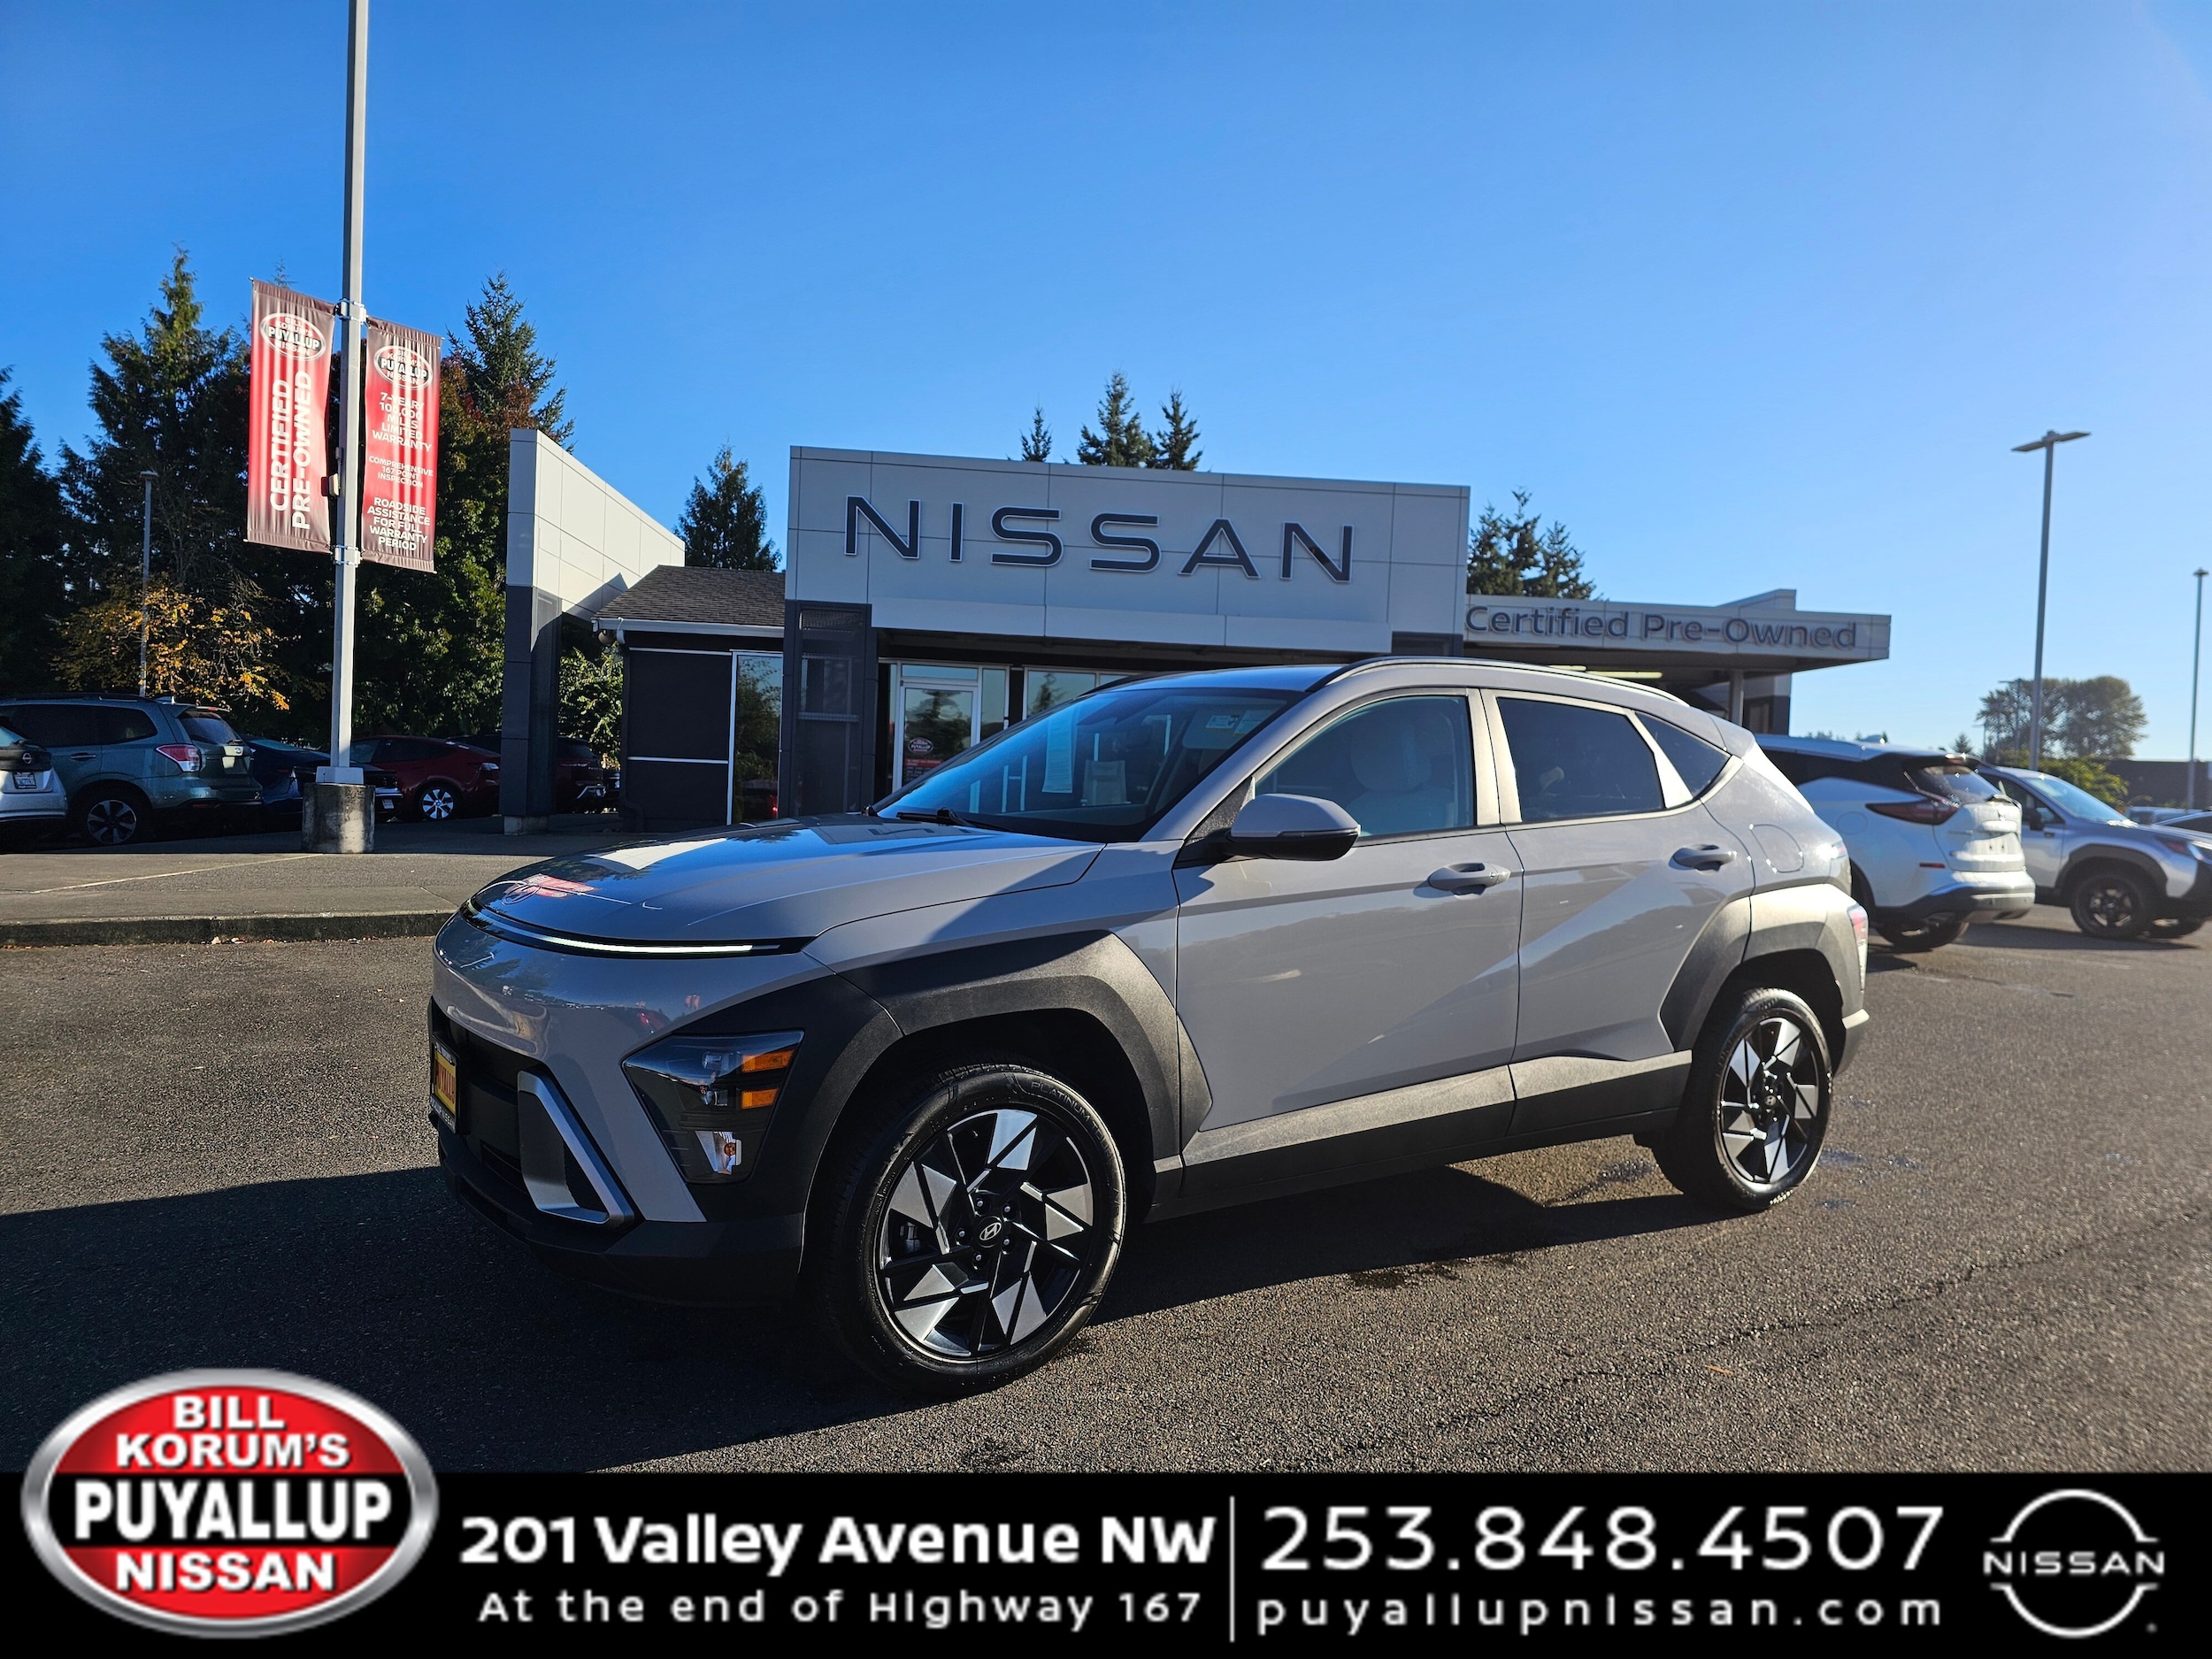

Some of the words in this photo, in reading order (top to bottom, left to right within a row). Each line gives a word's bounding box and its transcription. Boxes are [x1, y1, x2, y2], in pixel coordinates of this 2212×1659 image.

[268, 326, 320, 349] PUYALLUP
[274, 341, 311, 356] NISSAN
[380, 357, 427, 379] PUYALLUP
[379, 402, 422, 420] 100,000
[387, 413, 419, 428] MILES
[372, 429, 432, 452] WARRANTY
[381, 422, 423, 440] LIMITED
[270, 380, 290, 511] CERTIFIED
[292, 371, 311, 530] PRE-OWNED
[369, 456, 434, 476] COMPREHENSIVE
[382, 465, 395, 474] 167
[396, 468, 420, 479] POINT
[378, 472, 423, 488] INSPECTION
[367, 505, 431, 526] ASSISTANCE
[374, 497, 426, 515] ROADSIDE
[370, 525, 427, 544] WARRANTY
[373, 516, 396, 528] FOR
[397, 521, 422, 534] FULL
[379, 536, 417, 550] PERIOD
[843, 494, 1354, 584] NISSAN
[1464, 604, 1630, 641] Certified
[1642, 612, 1857, 650] Pre-Owned
[1031, 1081, 1090, 1123] PLATINUM
